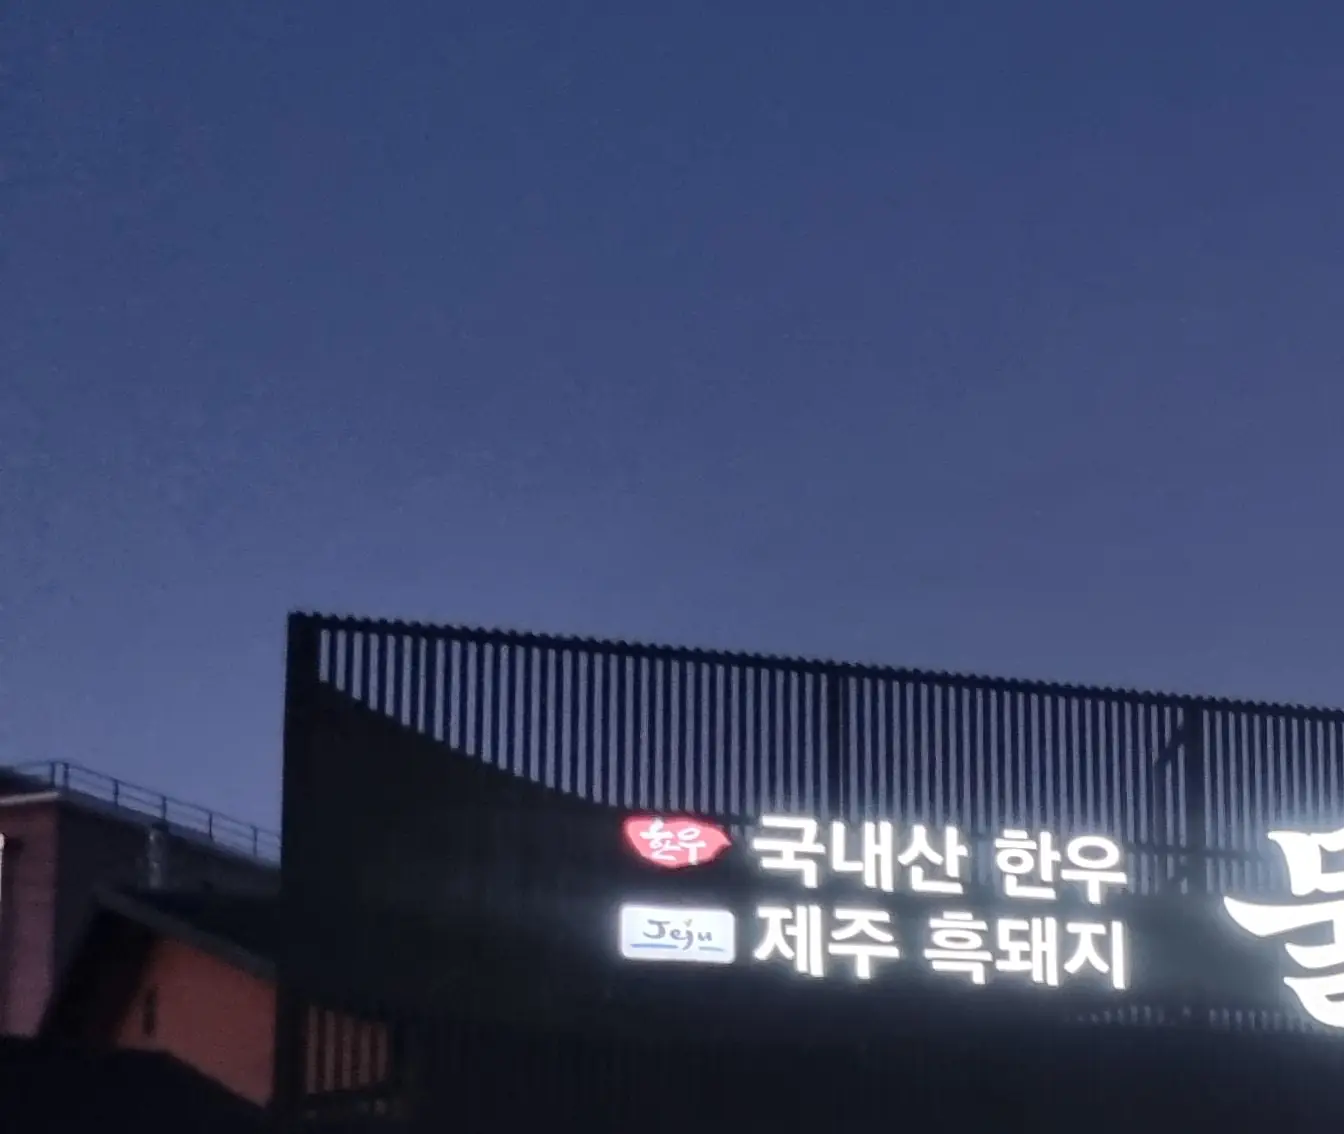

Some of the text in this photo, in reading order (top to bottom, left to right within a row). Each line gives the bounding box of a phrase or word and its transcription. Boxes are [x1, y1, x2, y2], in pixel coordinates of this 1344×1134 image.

[640, 816, 707, 866] 한우
[752, 815, 1128, 904] 국내산 한우
[642, 919, 714, 951] Jeju
[753, 904, 1128, 990] 제주 흑돼지
